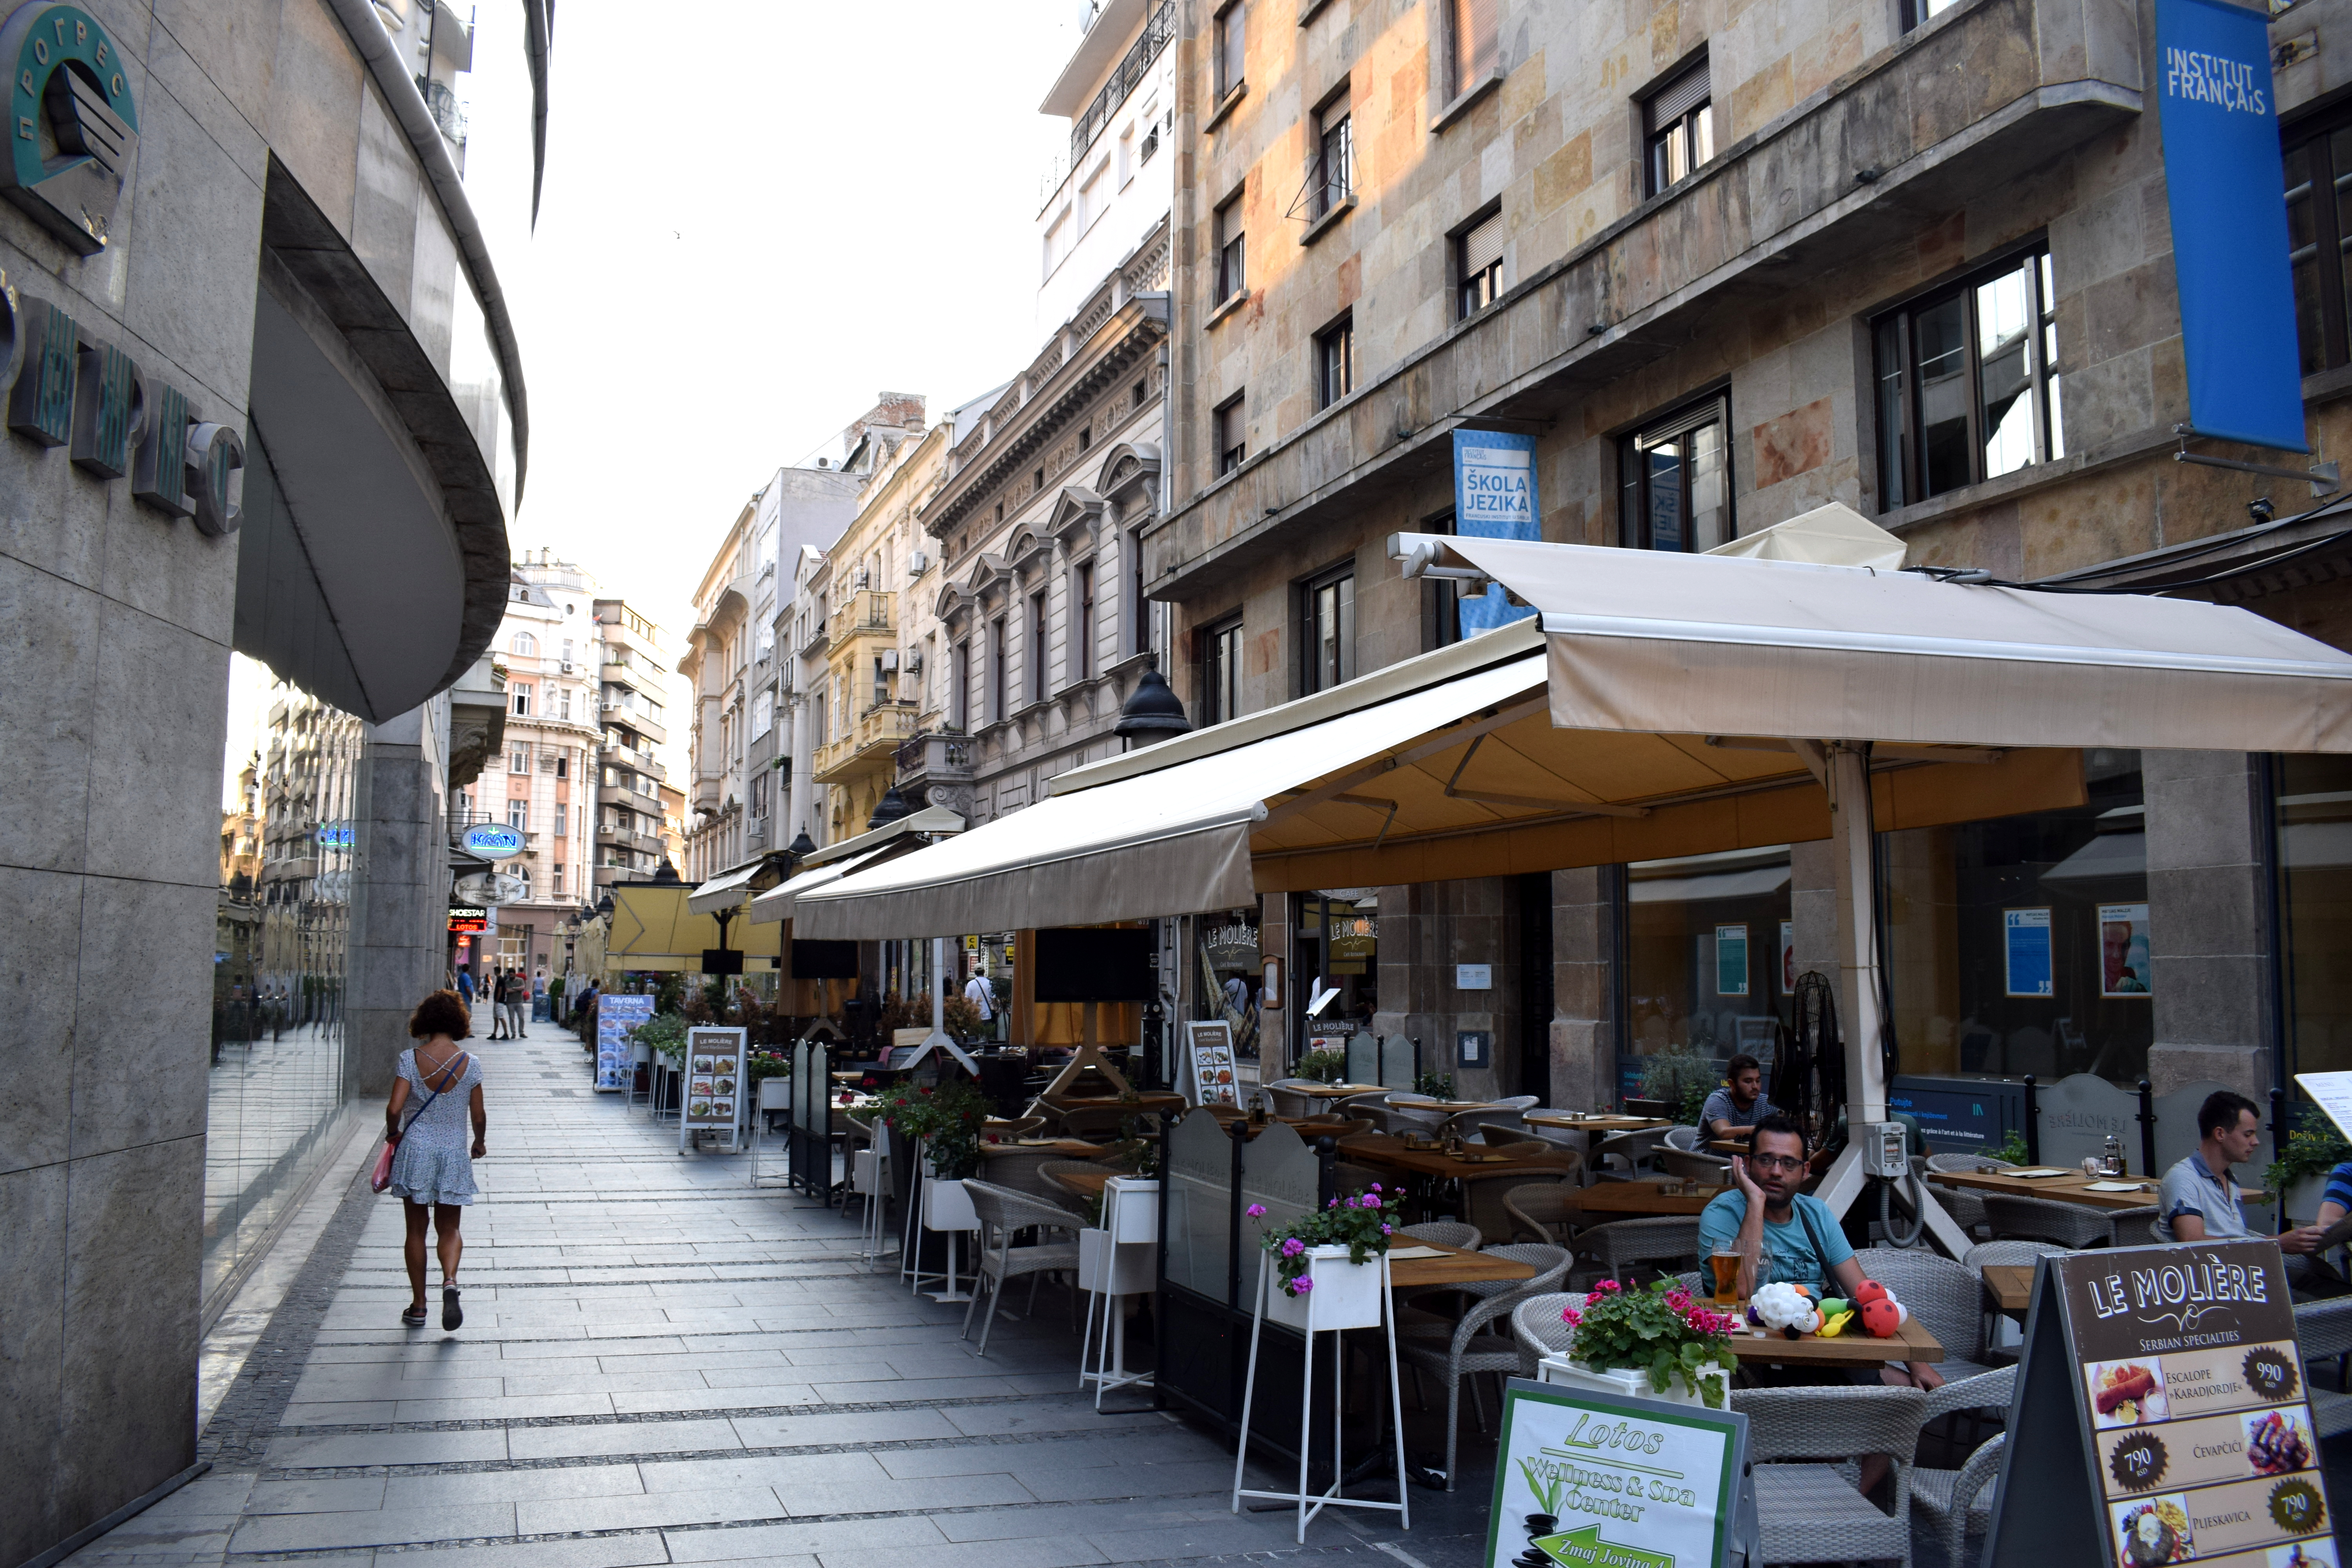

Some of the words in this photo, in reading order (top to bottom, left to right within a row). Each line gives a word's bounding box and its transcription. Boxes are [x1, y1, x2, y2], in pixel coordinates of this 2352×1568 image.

[2167, 47, 2253, 90] INSTITUT
[18, 18, 123, 141] ПРОГРЕС
[1467, 468, 1526, 492] ŠKOLA
[1466, 494, 1528, 512] JEZIKA
[1207, 928, 1217, 949] LE
[1330, 922, 1340, 940] LE
[1313, 1023, 1321, 1032] LE
[1323, 1021, 1354, 1031] MOLIÈRE
[1890, 1097, 1912, 1108] Putujte
[2088, 1274, 2128, 1318] LE
[2131, 1253, 2266, 1308] MOLIÈRE
[2140, 1337, 2181, 1351] SERBIAN
[2184, 1330, 2239, 1347] SPECIALTIES
[2165, 1369, 2211, 1384] ESCALOPE
[2256, 1362, 2282, 1382] 990
[1564, 1413, 1664, 1454] Lotos
[2124, 1447, 2151, 1472] 790
[1527, 1456, 1622, 1493] Wellness
[1626, 1476, 1644, 1497] &
[1648, 1480, 1695, 1507] Spa
[2136, 1467, 2148, 1477] RSD
[1566, 1489, 1645, 1523] Center
[2281, 1493, 2307, 1515] 790
[2192, 1510, 2251, 1530] PLJESKAVICA
[1557, 1538, 1598, 1564] Zmaj
